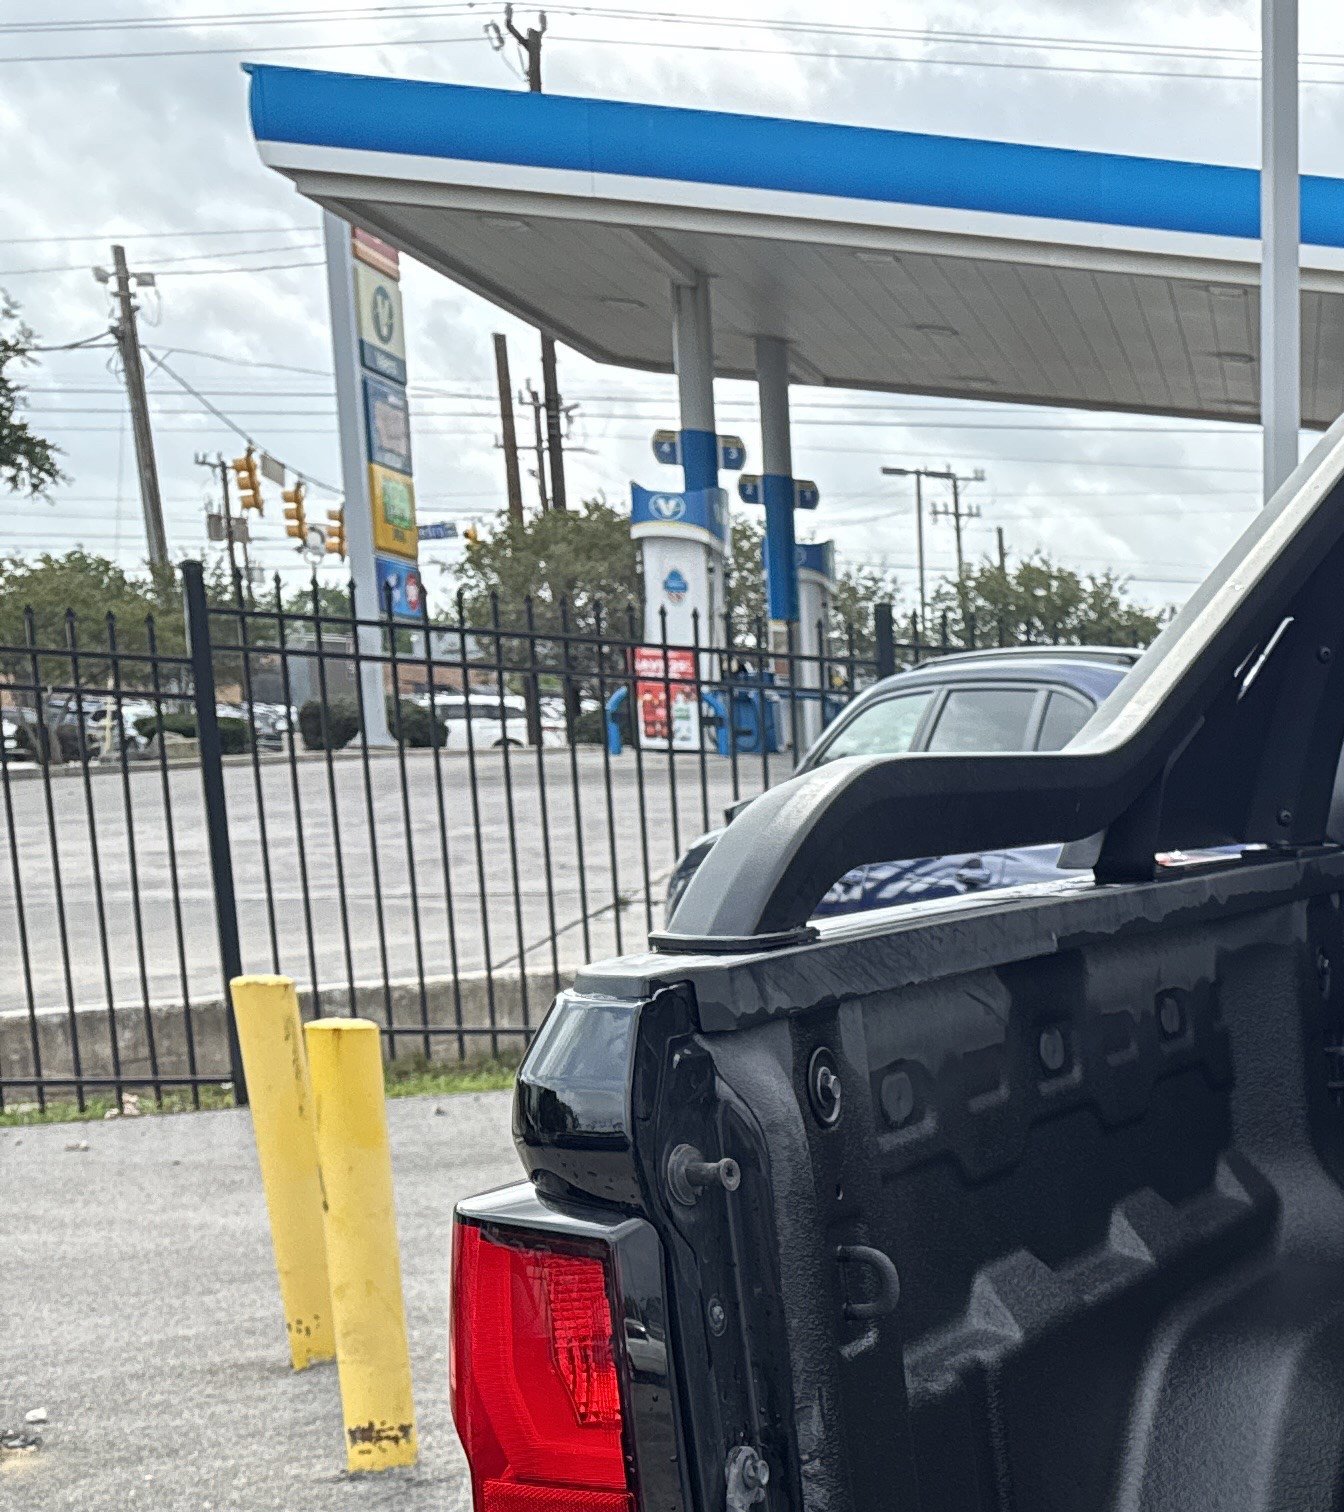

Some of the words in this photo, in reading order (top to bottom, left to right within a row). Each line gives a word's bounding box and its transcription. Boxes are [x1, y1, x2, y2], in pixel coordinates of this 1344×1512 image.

[661, 443, 671, 453] 4
[729, 447, 739, 459] 3
[655, 500, 677, 516] V
